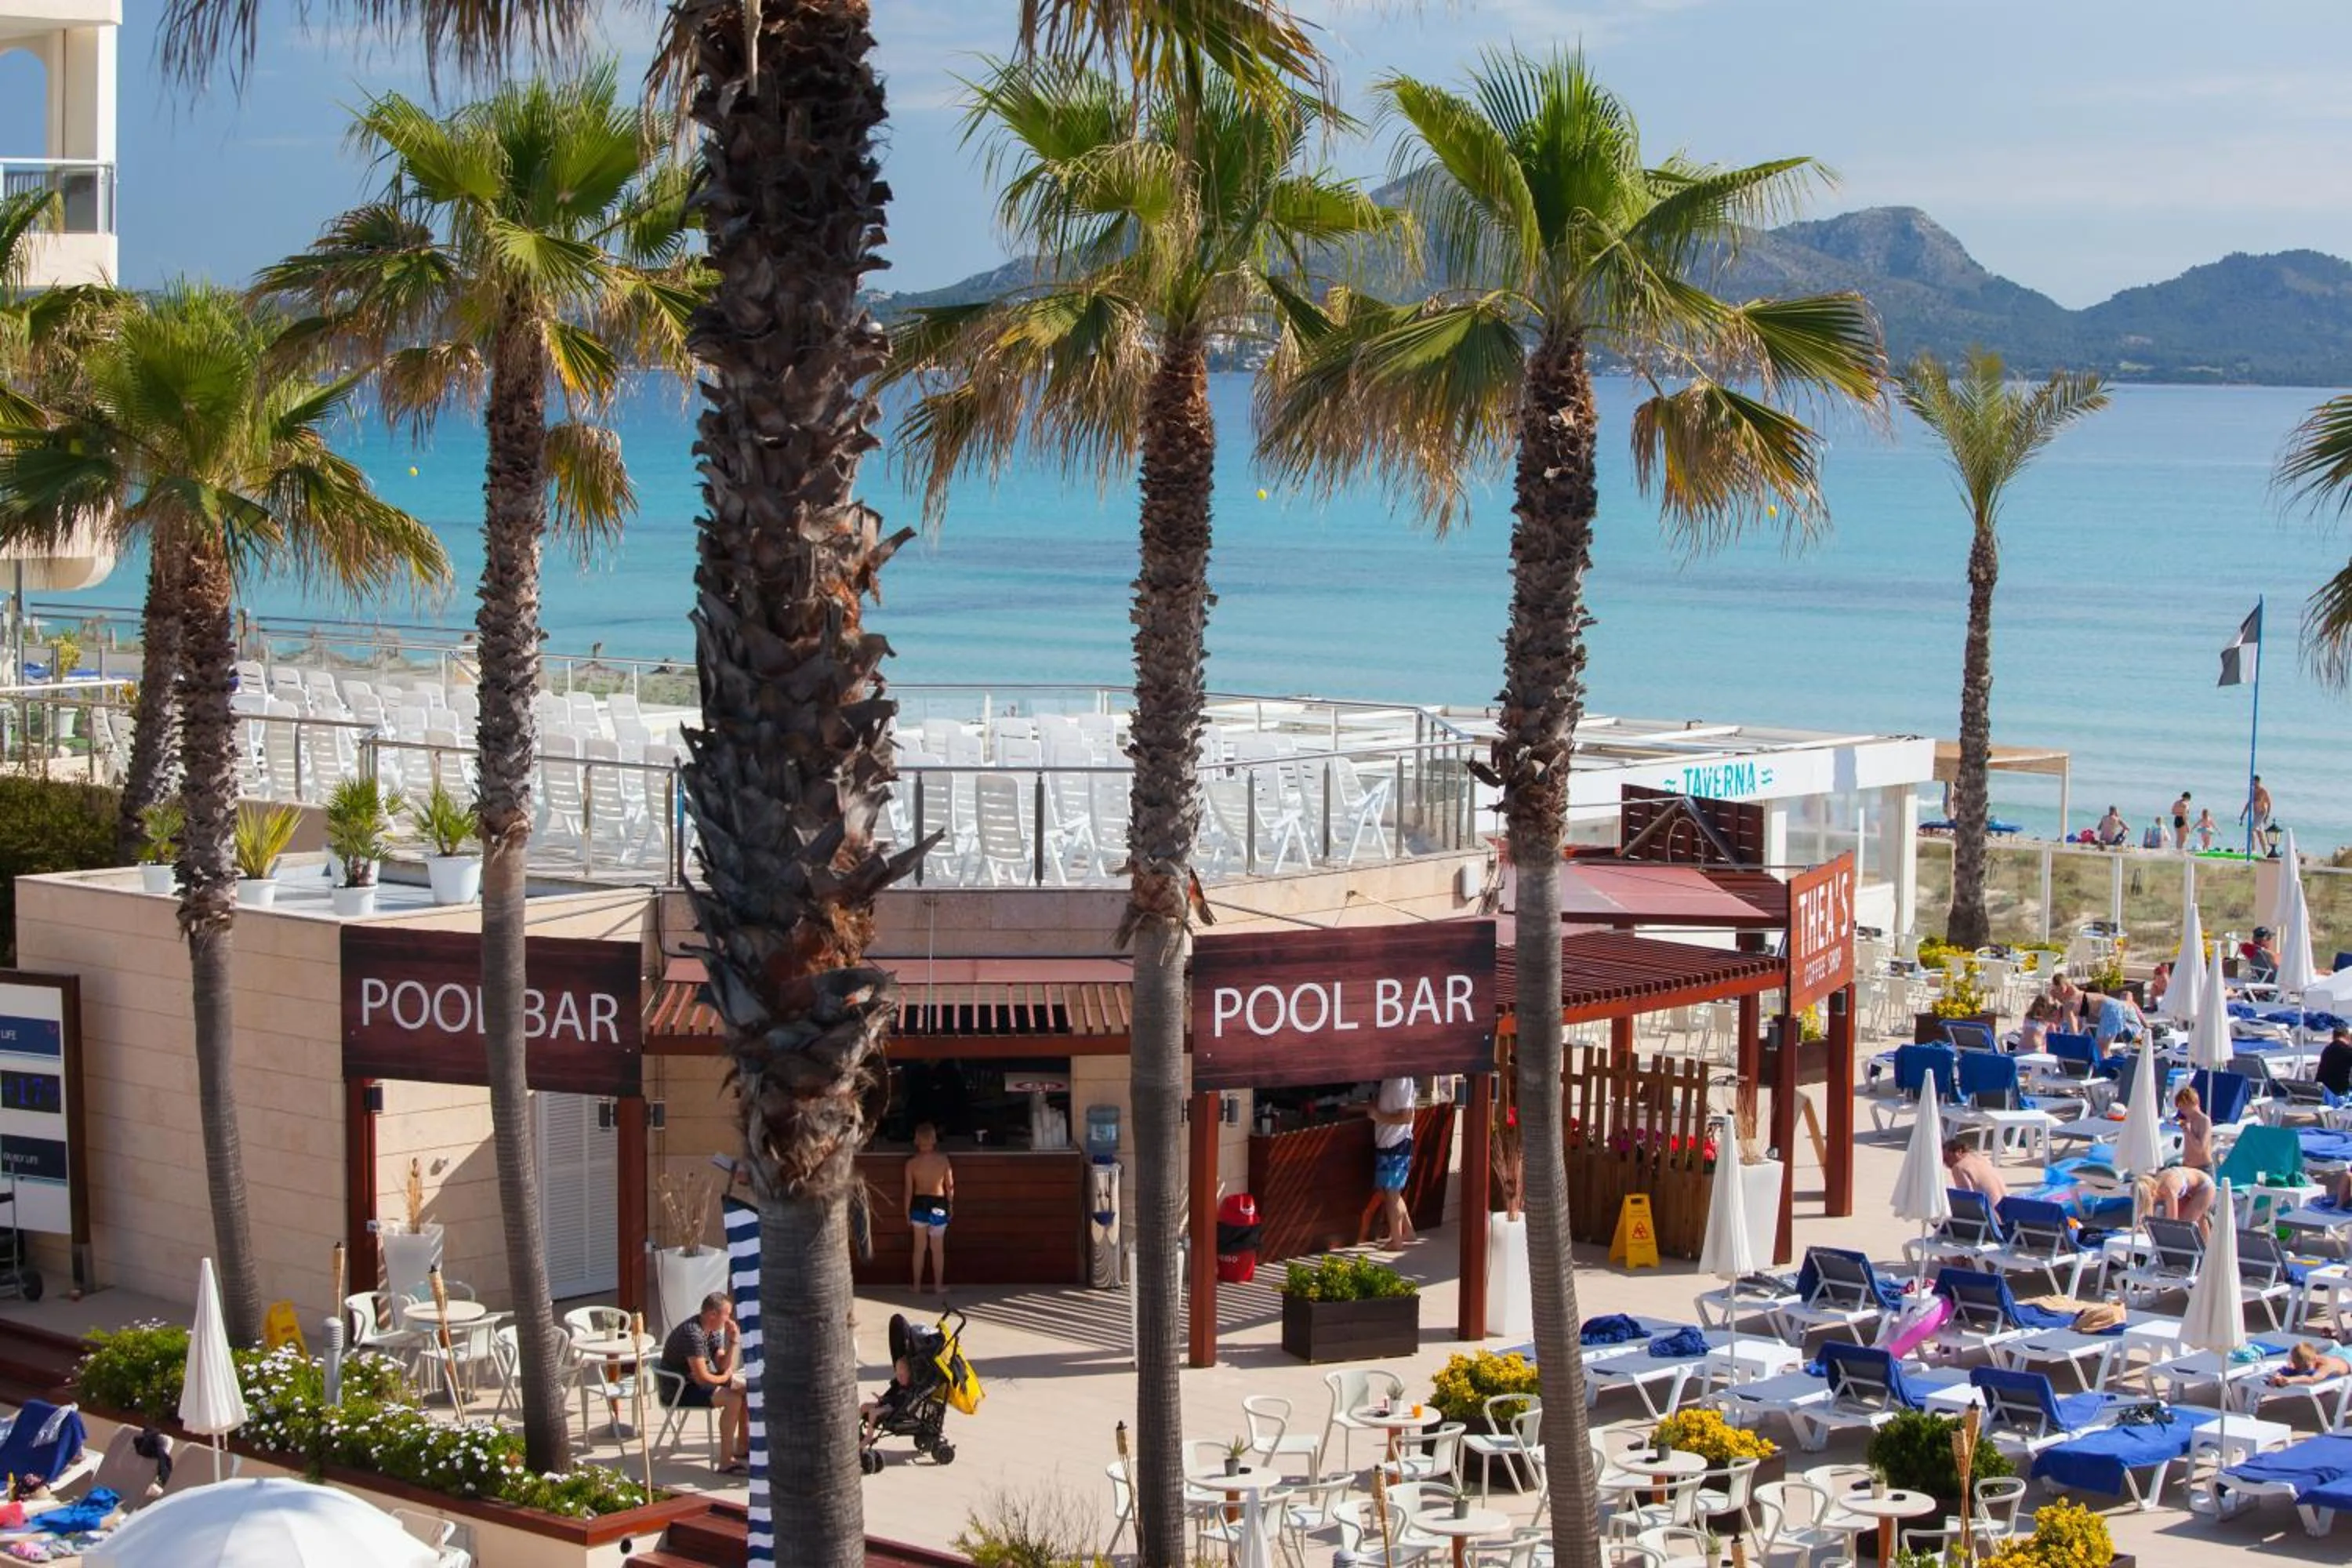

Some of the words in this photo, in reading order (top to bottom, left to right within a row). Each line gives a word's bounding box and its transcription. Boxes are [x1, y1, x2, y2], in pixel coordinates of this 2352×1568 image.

[1682, 760, 1756, 798] TAVERNA
[1798, 871, 1849, 959] THEA'S
[1805, 955, 1826, 987] COFFEE
[361, 978, 487, 1035] POOL
[524, 989, 621, 1044] BAR
[1214, 981, 1358, 1038] POOL
[1375, 975, 1475, 1029] BAR
